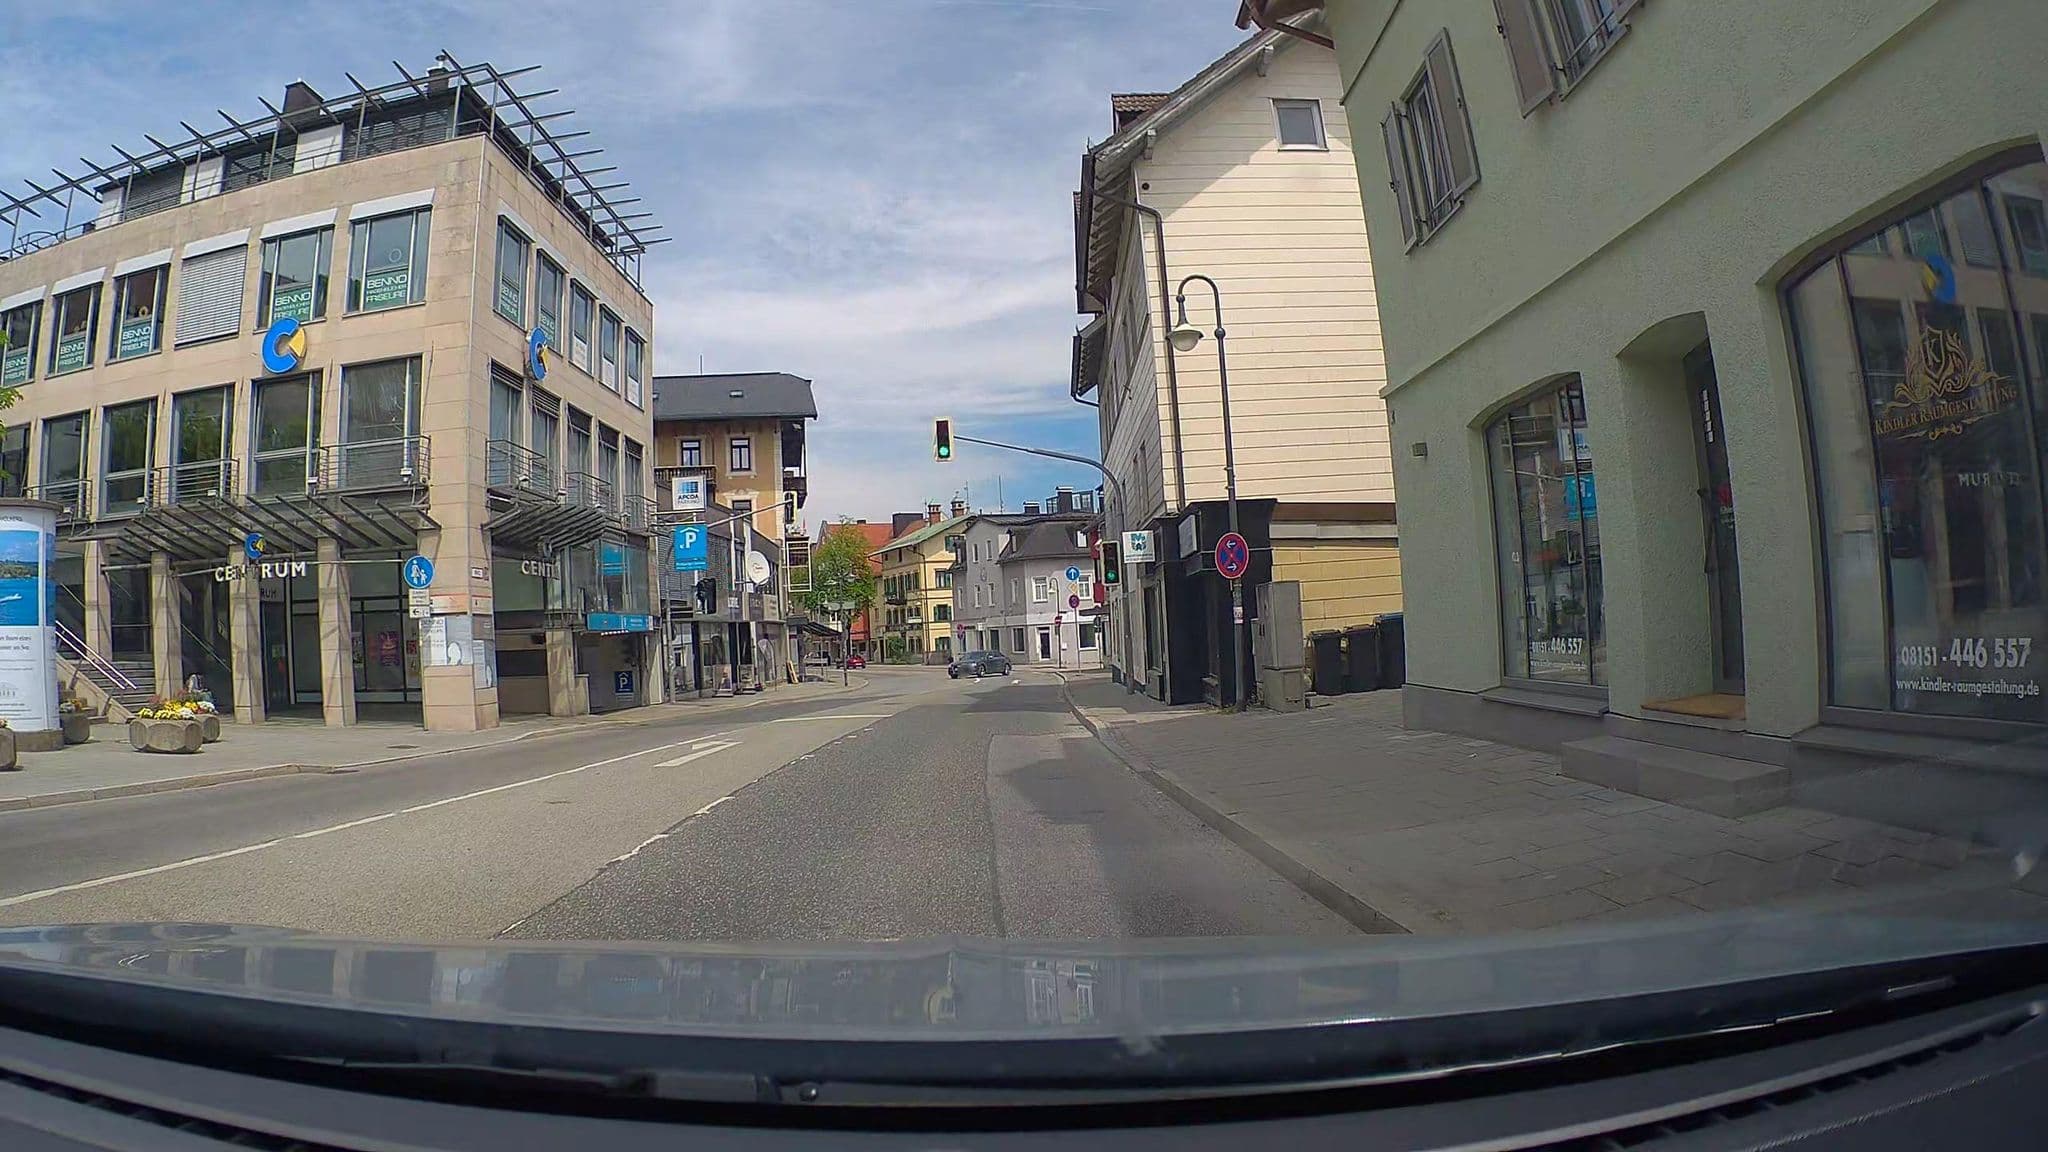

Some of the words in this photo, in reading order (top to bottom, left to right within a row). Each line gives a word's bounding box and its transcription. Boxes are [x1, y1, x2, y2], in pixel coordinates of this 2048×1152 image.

[367, 274, 407, 289] BENNO
[275, 292, 311, 306] BENNO
[122, 326, 151, 340] BENNO
[1567, 637, 1583, 655] 557
[1901, 646, 1938, 667] 08151
[1950, 638, 1988, 668] 446
[1994, 637, 2032, 668] 557
[1896, 676, 2040, 699] www.kindler-raumgestaltung.de
